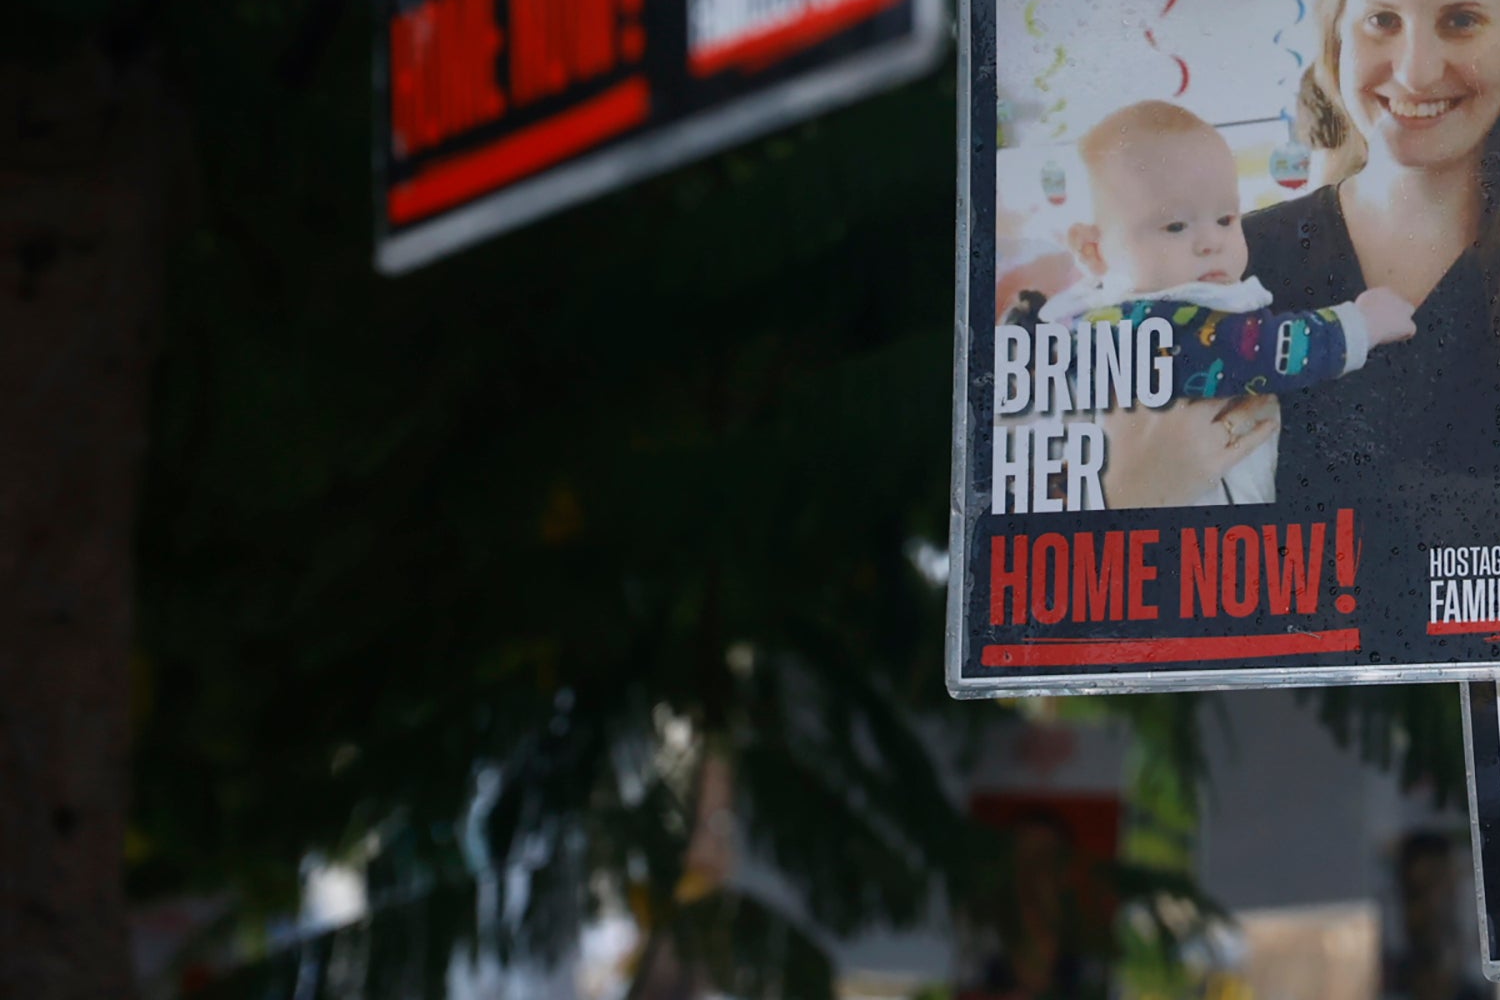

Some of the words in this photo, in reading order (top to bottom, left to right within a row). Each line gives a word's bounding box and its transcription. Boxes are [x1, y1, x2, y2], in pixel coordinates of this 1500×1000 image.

[995, 317, 1174, 413] BRING
[992, 422, 1109, 515] HER
[989, 528, 1160, 626] HOME
[1180, 508, 1361, 619] NOW!
